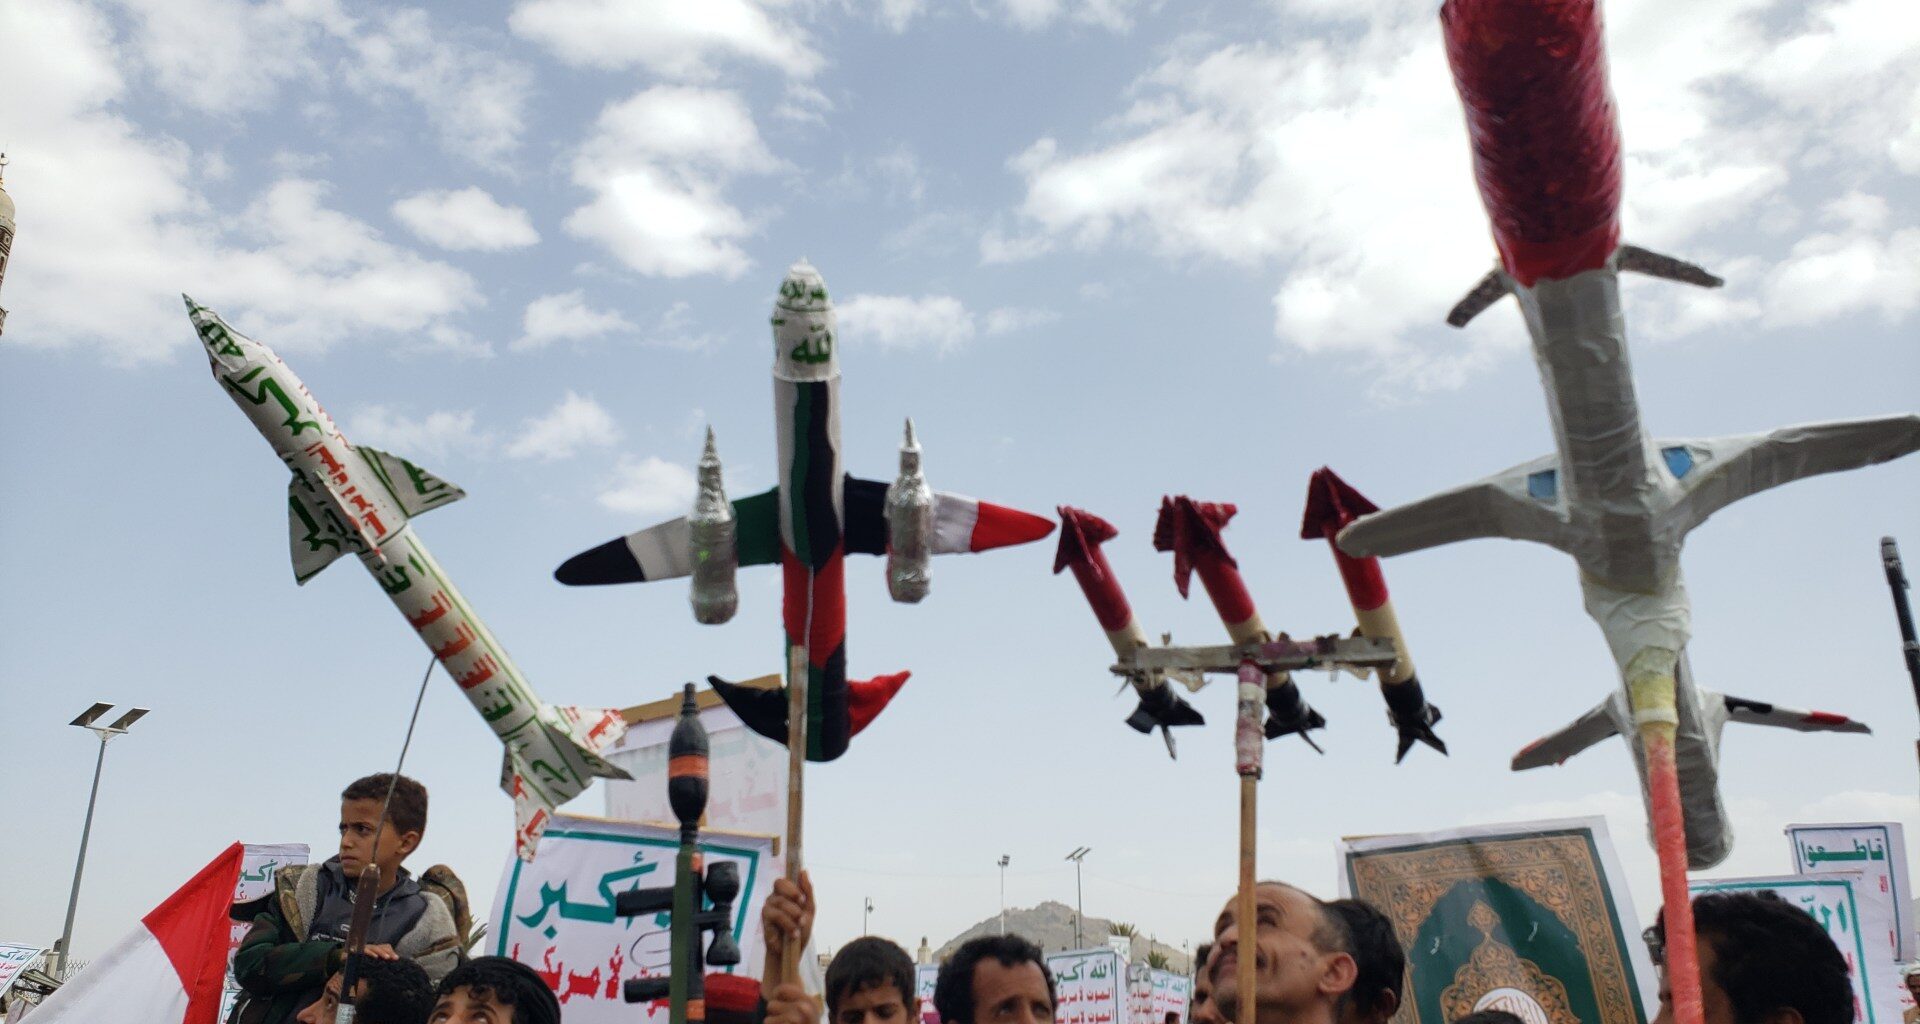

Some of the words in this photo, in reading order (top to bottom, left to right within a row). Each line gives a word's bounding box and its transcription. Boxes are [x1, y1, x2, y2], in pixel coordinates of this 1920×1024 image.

[305, 443, 349, 485] الموت
[1801, 837, 1885, 868] قاطعوا
[516, 851, 658, 940] أكبر
[1090, 959, 1114, 979] الله
[1086, 987, 1114, 1004] الموت
